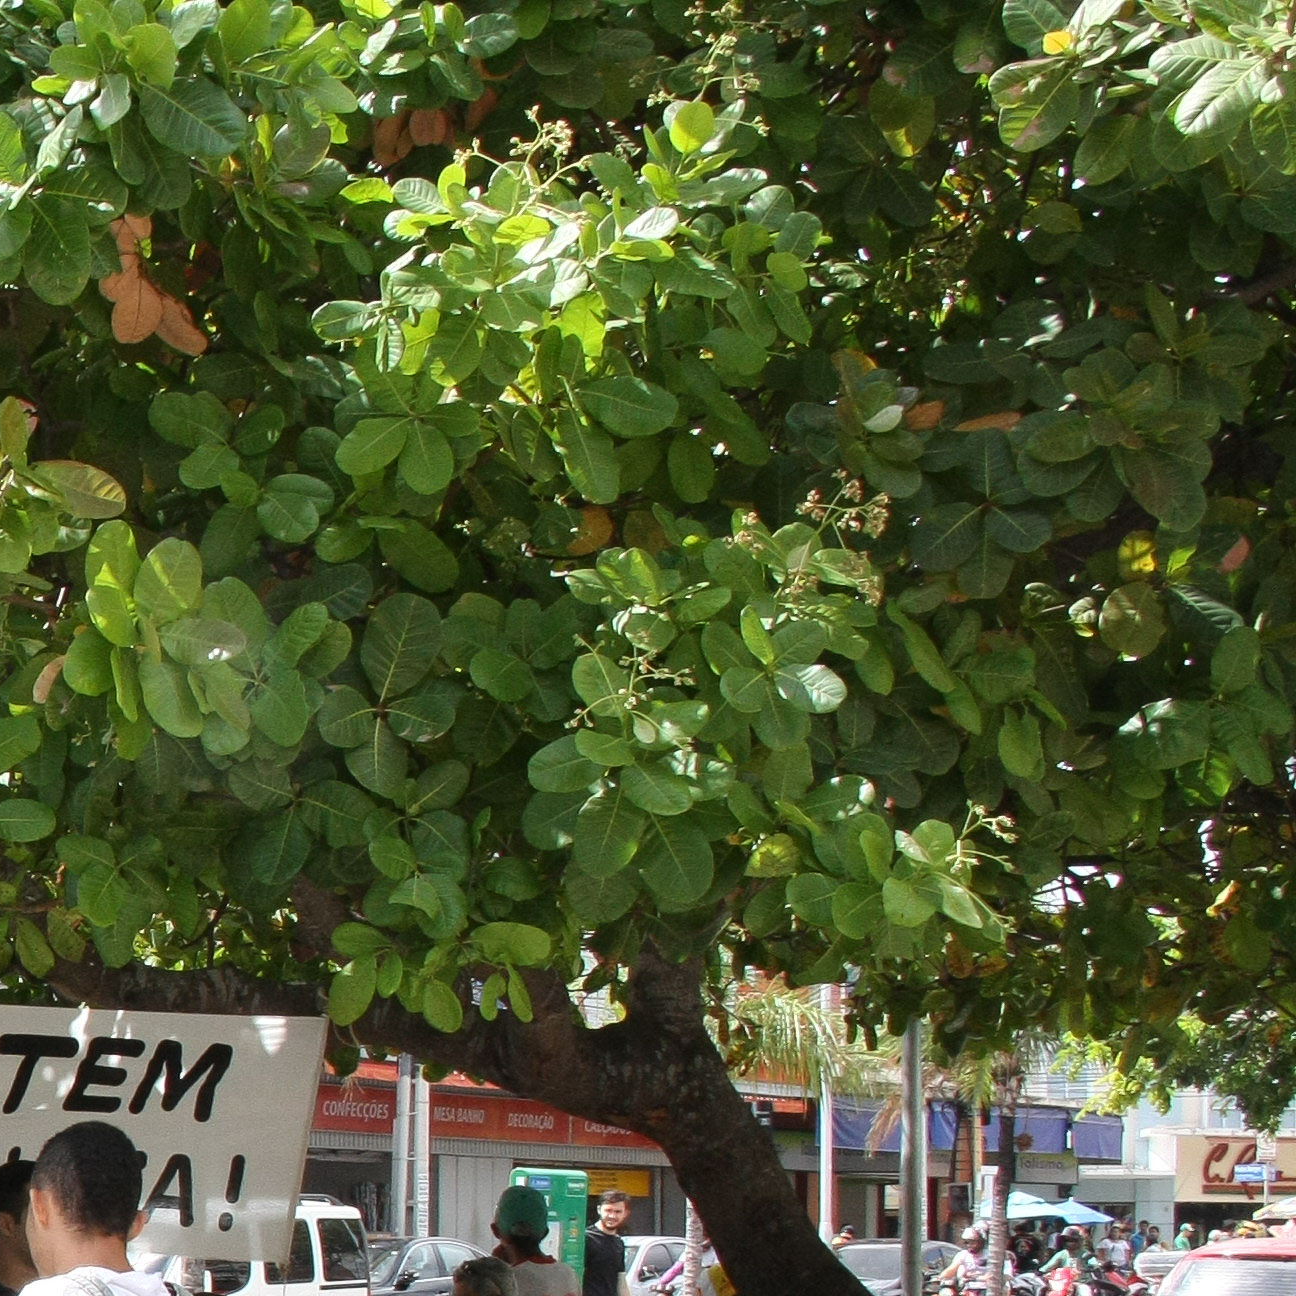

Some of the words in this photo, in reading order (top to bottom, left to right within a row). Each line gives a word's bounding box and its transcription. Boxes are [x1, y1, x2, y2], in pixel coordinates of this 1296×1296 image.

[323, 1099, 389, 1122] CONFECÇÕES
[433, 1107, 455, 1123] MESA
[508, 1112, 554, 1131] DECORAÇÃO
